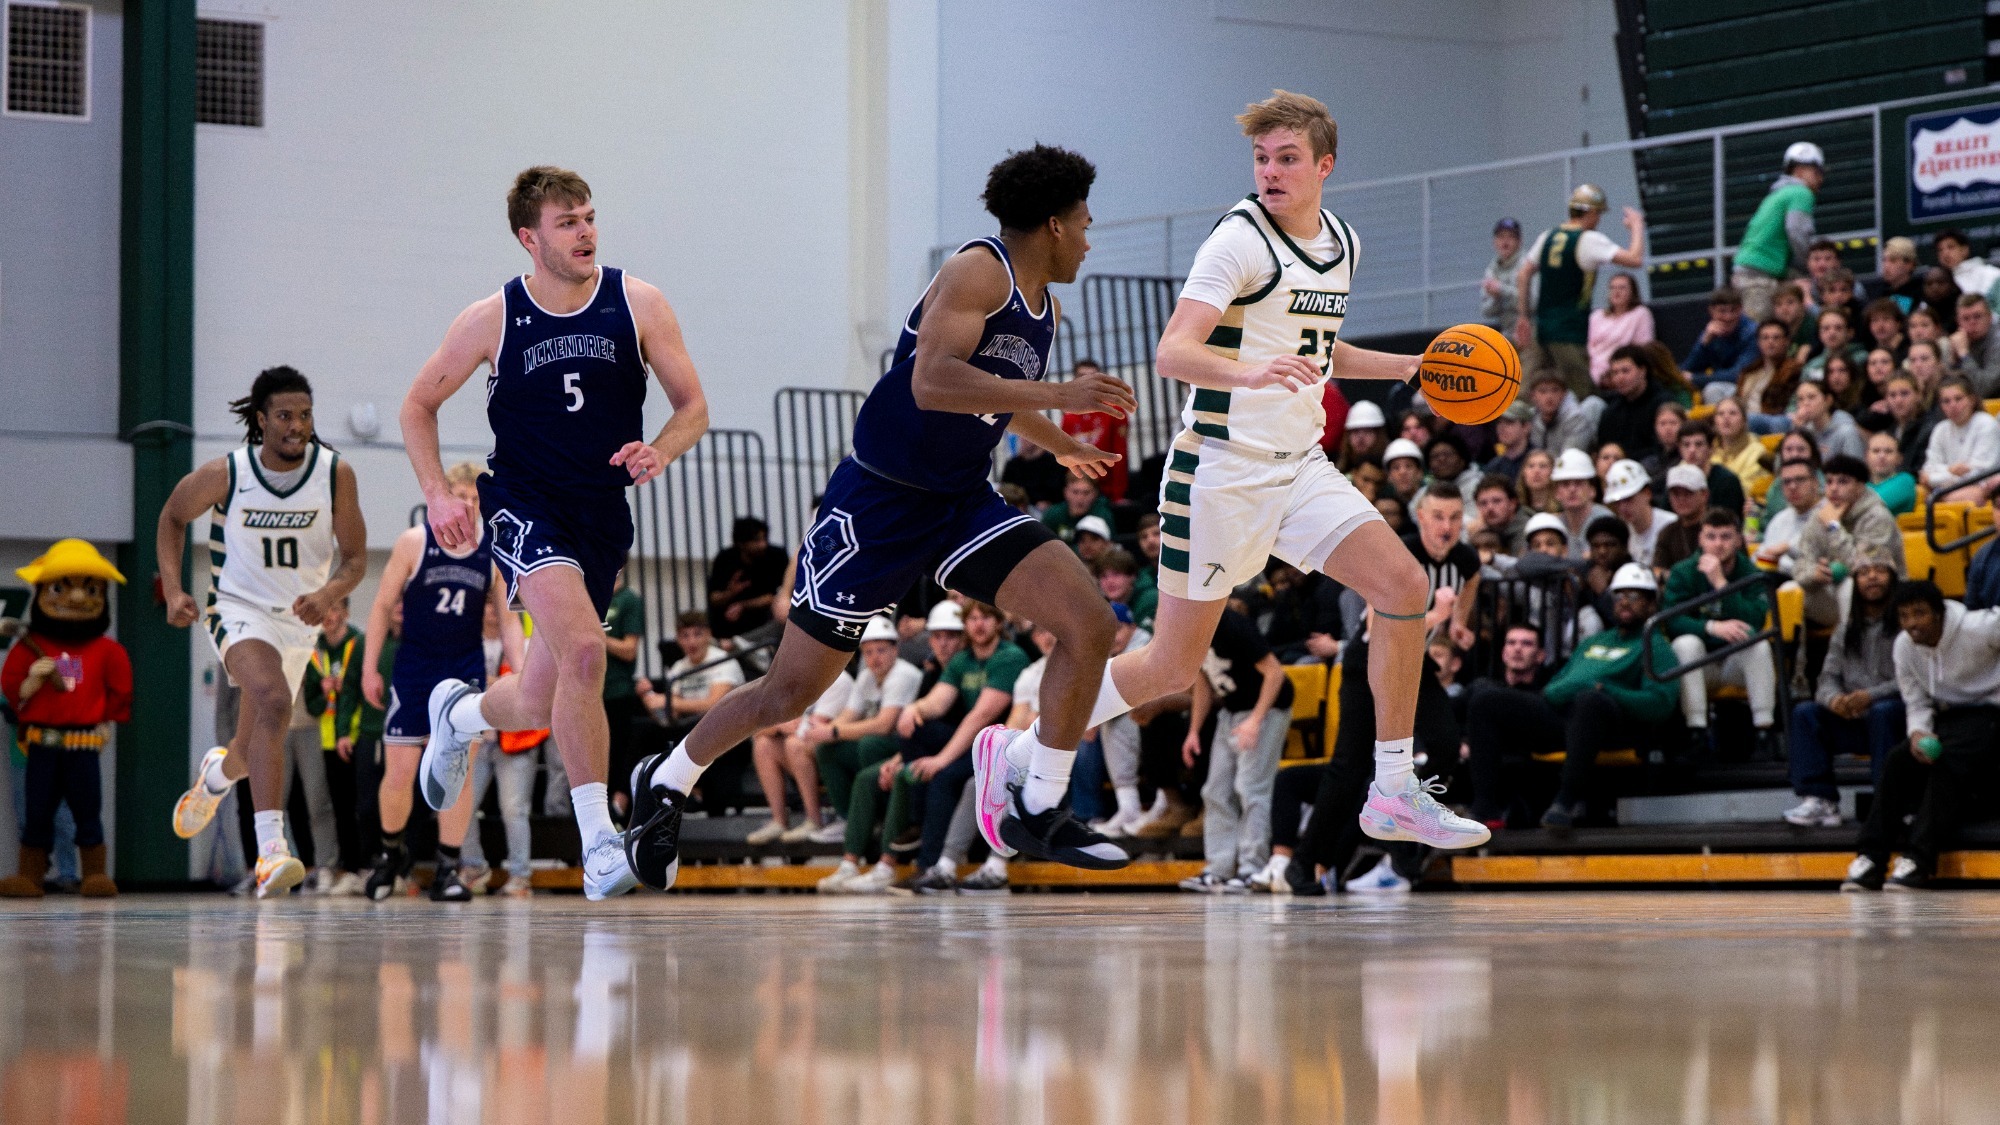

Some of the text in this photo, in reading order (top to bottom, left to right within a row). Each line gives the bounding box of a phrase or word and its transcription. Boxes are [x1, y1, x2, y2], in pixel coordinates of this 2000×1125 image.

[1935, 134, 1989, 155] REALTY
[1548, 232, 1568, 267] 2
[522, 334, 617, 375] MCKENDREE
[1431, 340, 1477, 359] NCAA
[563, 372, 585, 412] 5
[1421, 368, 1478, 393] Wilson
[246, 511, 315, 528] MINERS
[262, 537, 299, 569] 10
[435, 587, 466, 616] 24
